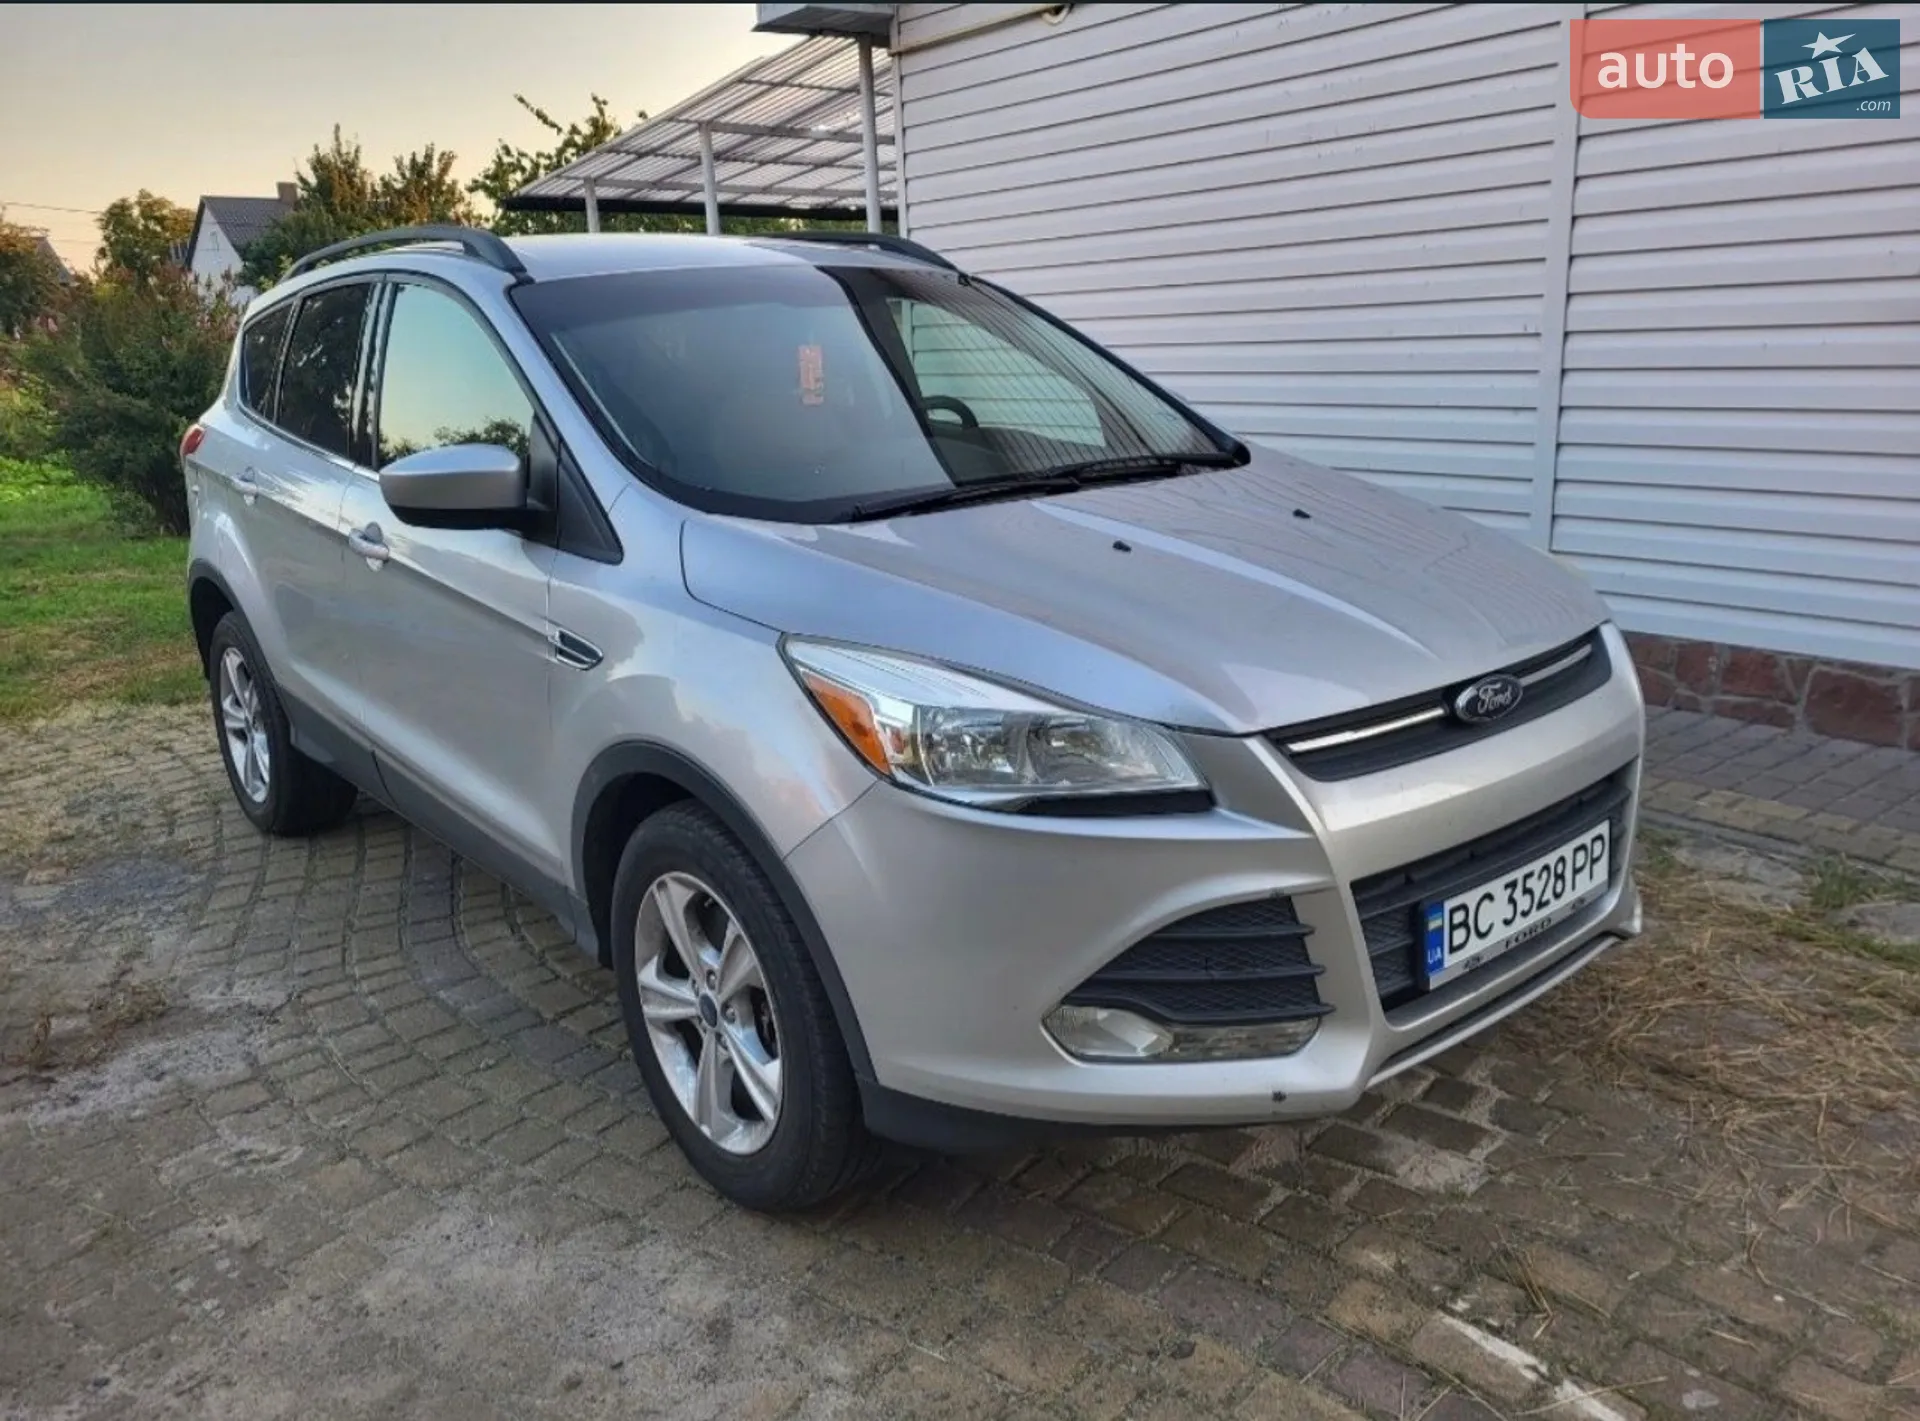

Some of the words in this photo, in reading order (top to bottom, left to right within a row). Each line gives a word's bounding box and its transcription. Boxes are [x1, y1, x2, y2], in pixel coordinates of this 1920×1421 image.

[1477, 682, 1512, 714] Ford
[1449, 892, 1495, 954] BC
[1503, 855, 1566, 927] 3528
[1571, 834, 1605, 891] PP
[1427, 946, 1443, 964] UA
